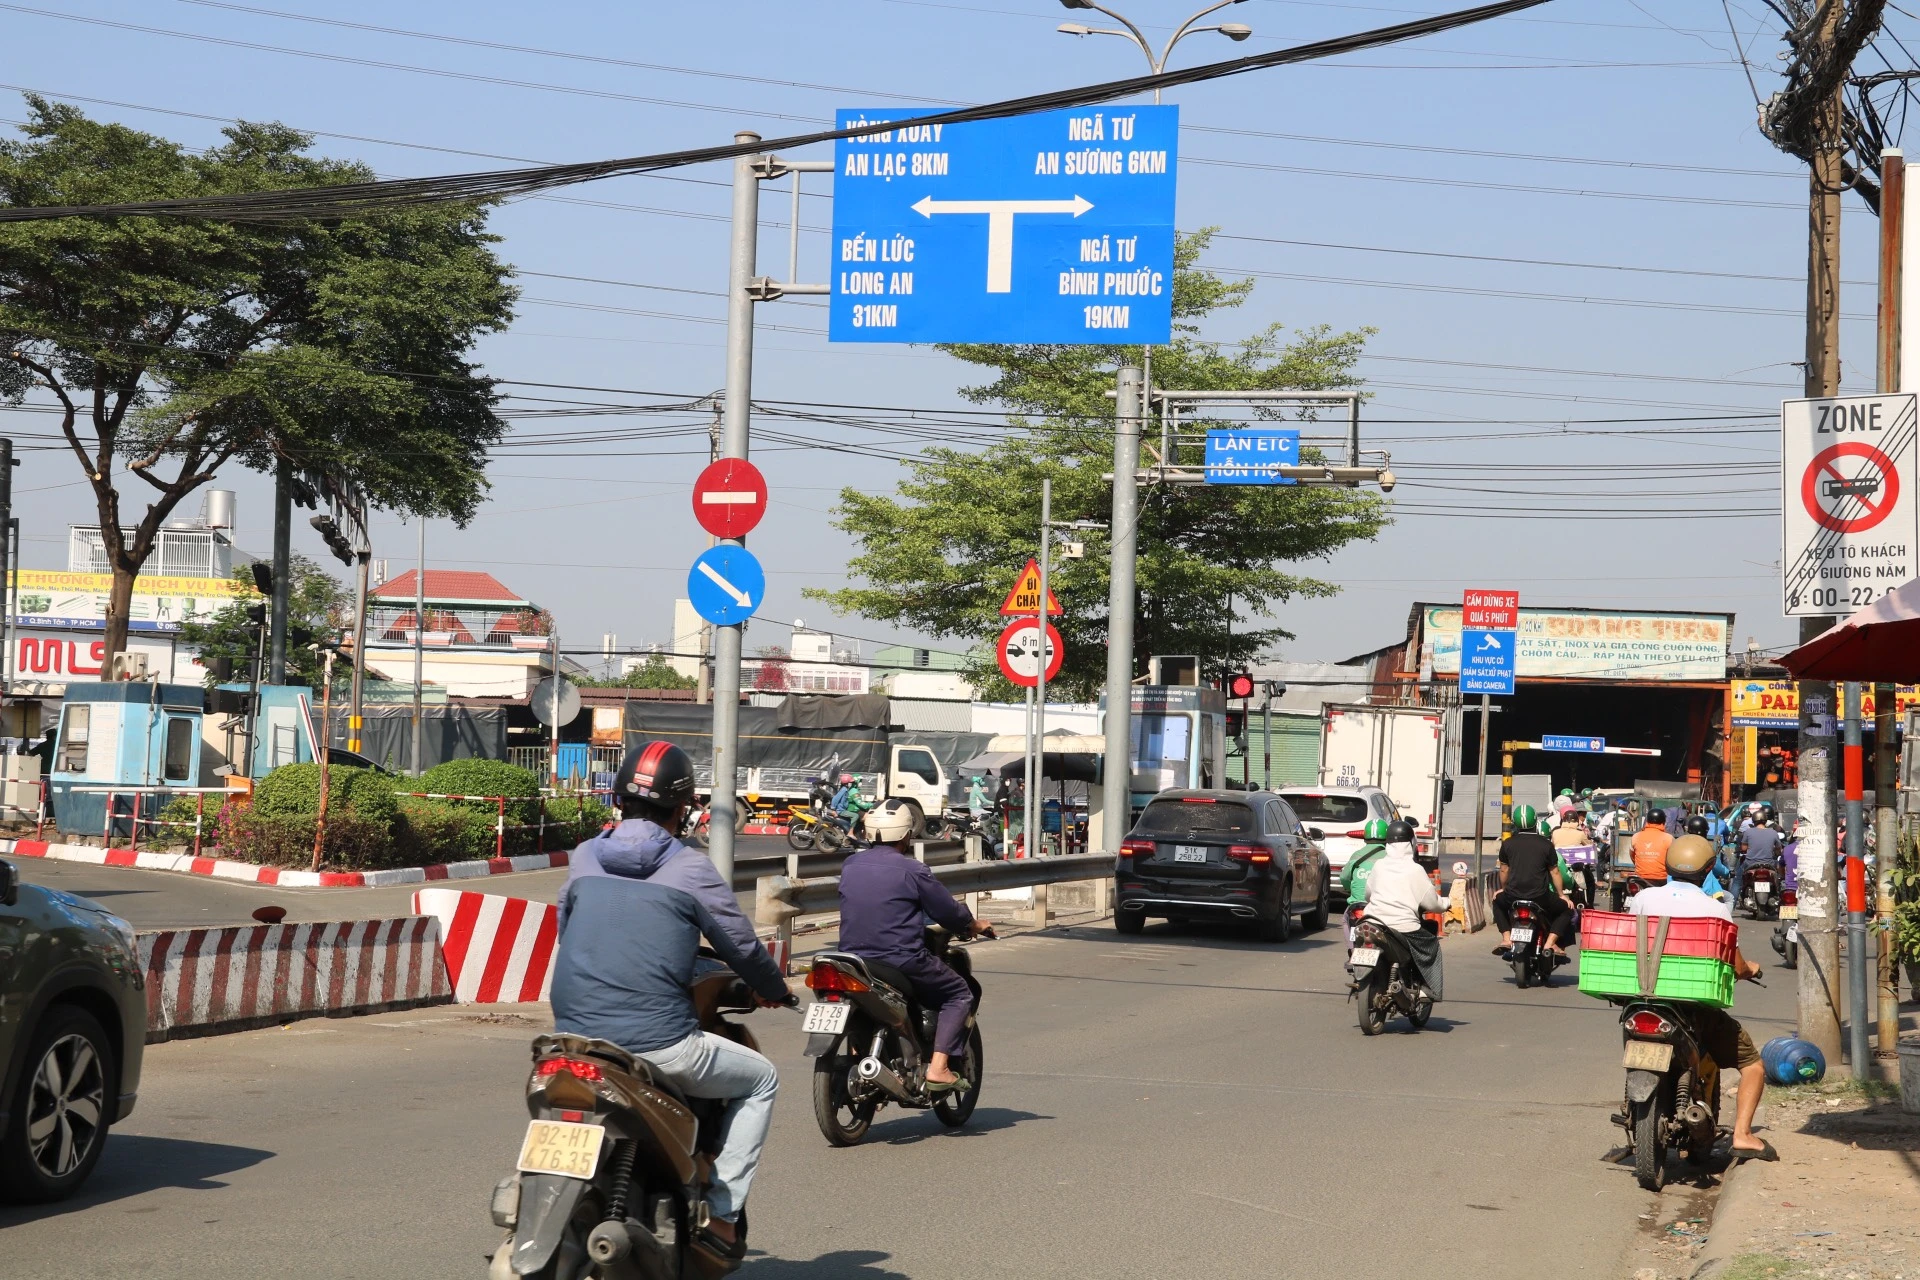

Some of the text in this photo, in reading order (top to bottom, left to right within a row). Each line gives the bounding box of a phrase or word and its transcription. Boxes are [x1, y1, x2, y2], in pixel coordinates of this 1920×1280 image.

[846, 114, 943, 143] VÒNG XUAY
[1069, 113, 1136, 141] NGÃ TƯ
[845, 153, 949, 182] AN LẠC 8KM
[1035, 148, 1167, 175] AN SƯƠNG 6KM
[842, 231, 915, 262] BẾN LỨC
[1080, 234, 1138, 262] NGÃ TƯ
[841, 271, 913, 295] LONG AN
[1059, 265, 1163, 296] BÌNH PHƯỚC
[852, 304, 897, 328] 31KM
[1083, 305, 1130, 328] 19KM
[1817, 403, 1882, 433] ZONE
[1214, 433, 1290, 451] LÀN ETC
[1210, 457, 1248, 477] HỖN
[1806, 548, 1822, 560] XE
[1839, 544, 1856, 558] TÔ
[1861, 542, 1906, 558] KHÁCH
[1799, 561, 1906, 579] CÓ GIƯỜNG NẰM
[1027, 577, 1037, 590] ĐI
[1466, 592, 1515, 608] CẤM DỪNG XE
[71, 619, 97, 627] TP.HCM
[1470, 610, 1509, 624] QUÁ 5 PHÚT
[1022, 635, 1038, 647] 8 m
[1565, 640, 1589, 648] INOX
[1611, 642, 1628, 650] GIA
[1472, 656, 1484, 664] KHU
[1643, 653, 1671, 662] THEO
[1483, 680, 1506, 690] CAMERA
[1545, 738, 1554, 747] LÀN
[1556, 740, 1562, 748] XE
[1341, 765, 1356, 776] 51D
[1178, 853, 1203, 862] 258.22
[1184, 846, 1198, 854] 51K
[813, 1006, 844, 1019] 51-Z8
[809, 1018, 838, 1032] 5121
[537, 1125, 591, 1149] 92-H1
